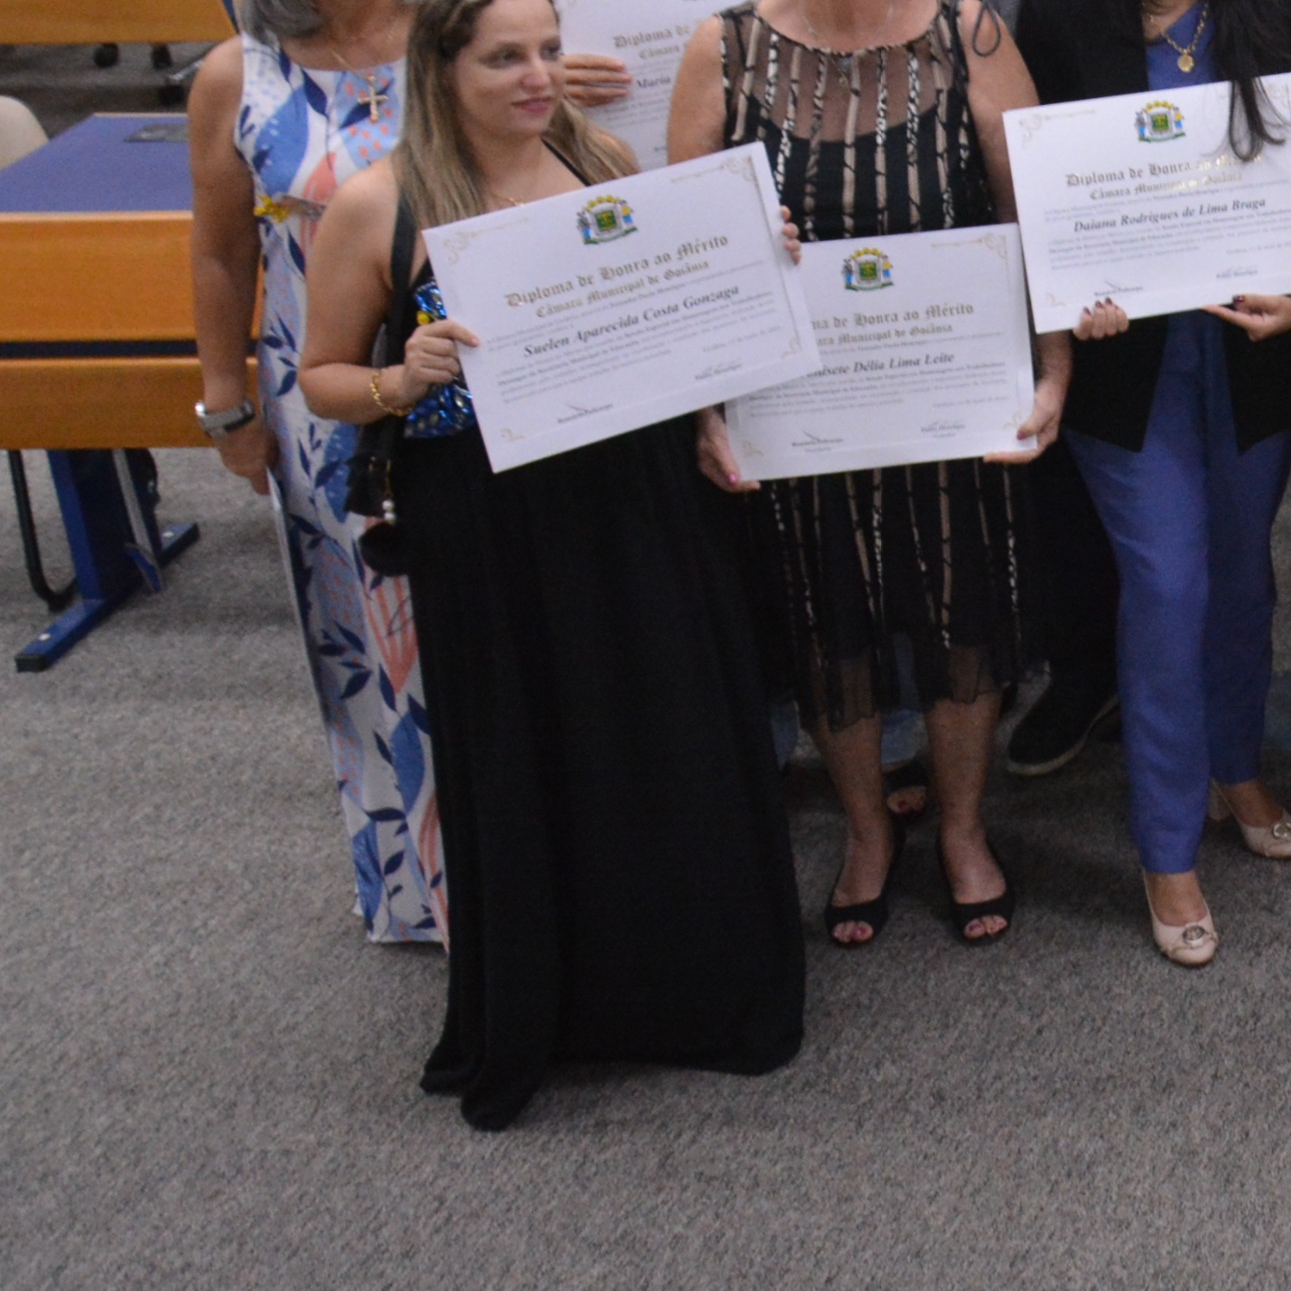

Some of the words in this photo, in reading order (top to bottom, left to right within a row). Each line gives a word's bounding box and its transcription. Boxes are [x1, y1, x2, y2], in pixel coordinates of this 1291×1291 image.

[1065, 169, 1125, 187] Diploma
[1129, 167, 1143, 179] de
[1089, 186, 1131, 201] Câmara
[1073, 217, 1117, 233] Daiana
[1120, 208, 1179, 229] Rodrigues
[1182, 206, 1195, 218] de
[1199, 203, 1228, 215] Lima
[1231, 197, 1267, 212] Braga
[504, 279, 574, 308] Diploma
[576, 270, 594, 288] de
[654, 251, 672, 266] ao
[676, 234, 728, 260] Mérito
[536, 296, 584, 318] Câmara
[587, 279, 645, 306] Municipal
[646, 273, 660, 286] de
[664, 260, 710, 281] Goiânia
[523, 335, 570, 358] Suelen
[576, 314, 640, 344] Aparecida
[642, 302, 680, 322] Costa
[682, 284, 740, 310] Gonzaga
[833, 316, 848, 328] de
[902, 309, 919, 322] ao
[925, 302, 974, 319] Mérito
[838, 329, 891, 346] Municipal
[894, 327, 906, 338] de
[909, 323, 953, 337] Goiânia
[853, 360, 885, 374] Délia
[889, 356, 920, 370] Lima
[924, 353, 955, 366] Leite
